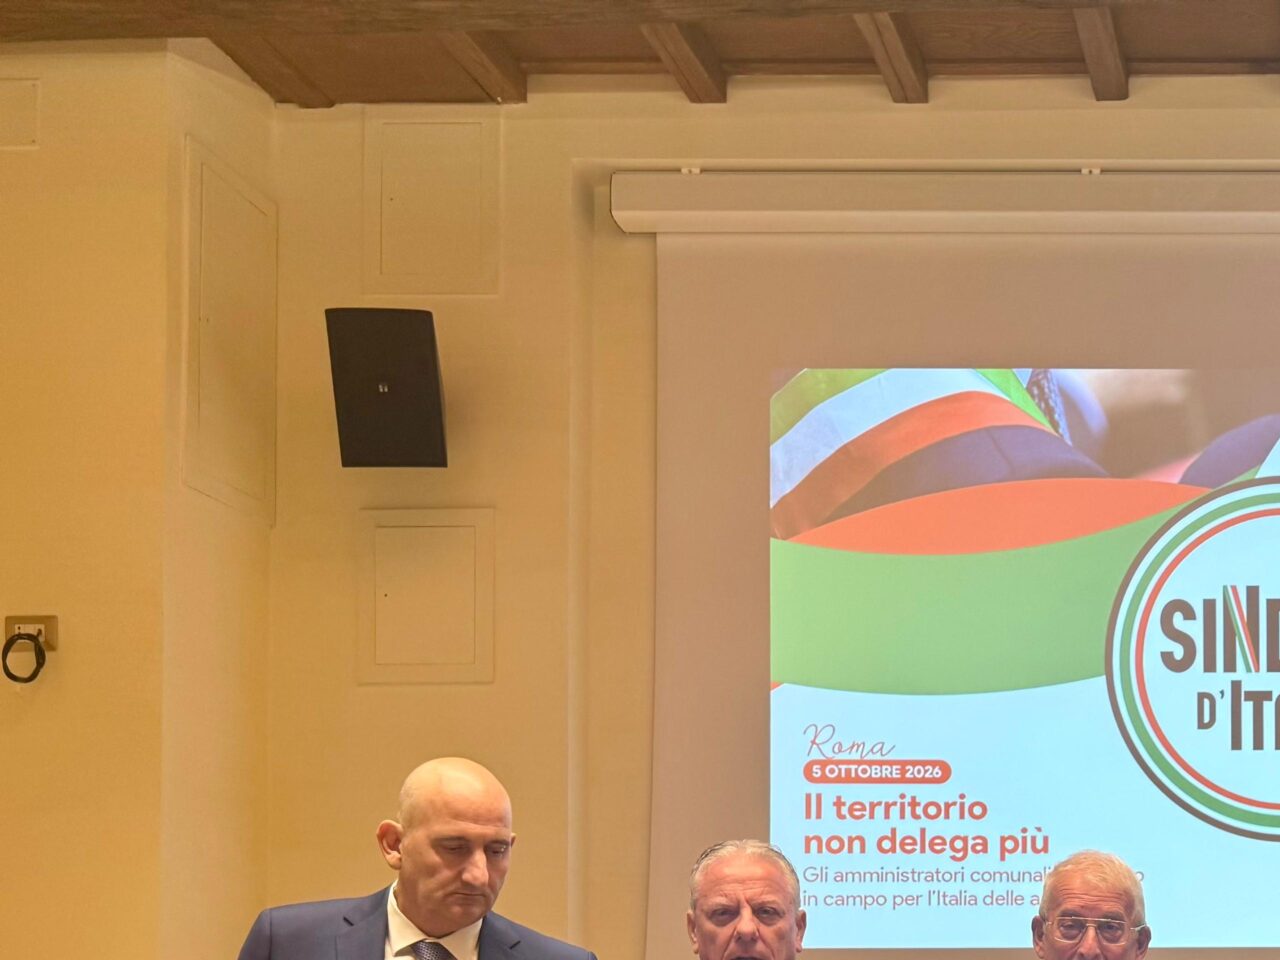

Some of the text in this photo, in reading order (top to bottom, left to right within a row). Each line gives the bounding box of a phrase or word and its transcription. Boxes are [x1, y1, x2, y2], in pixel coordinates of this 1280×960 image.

[803, 723, 896, 760] Roma
[812, 764, 943, 779] 5 OTTOBRE 2026
[804, 792, 989, 821] Il territorio
[804, 826, 1050, 863] non delega più
[802, 866, 1051, 883] Gli amministratori comunal
[803, 890, 818, 907] in
[823, 894, 888, 911] campo
[892, 894, 924, 911] per
[927, 889, 979, 907] l'Italia
[982, 889, 1025, 907] delle
